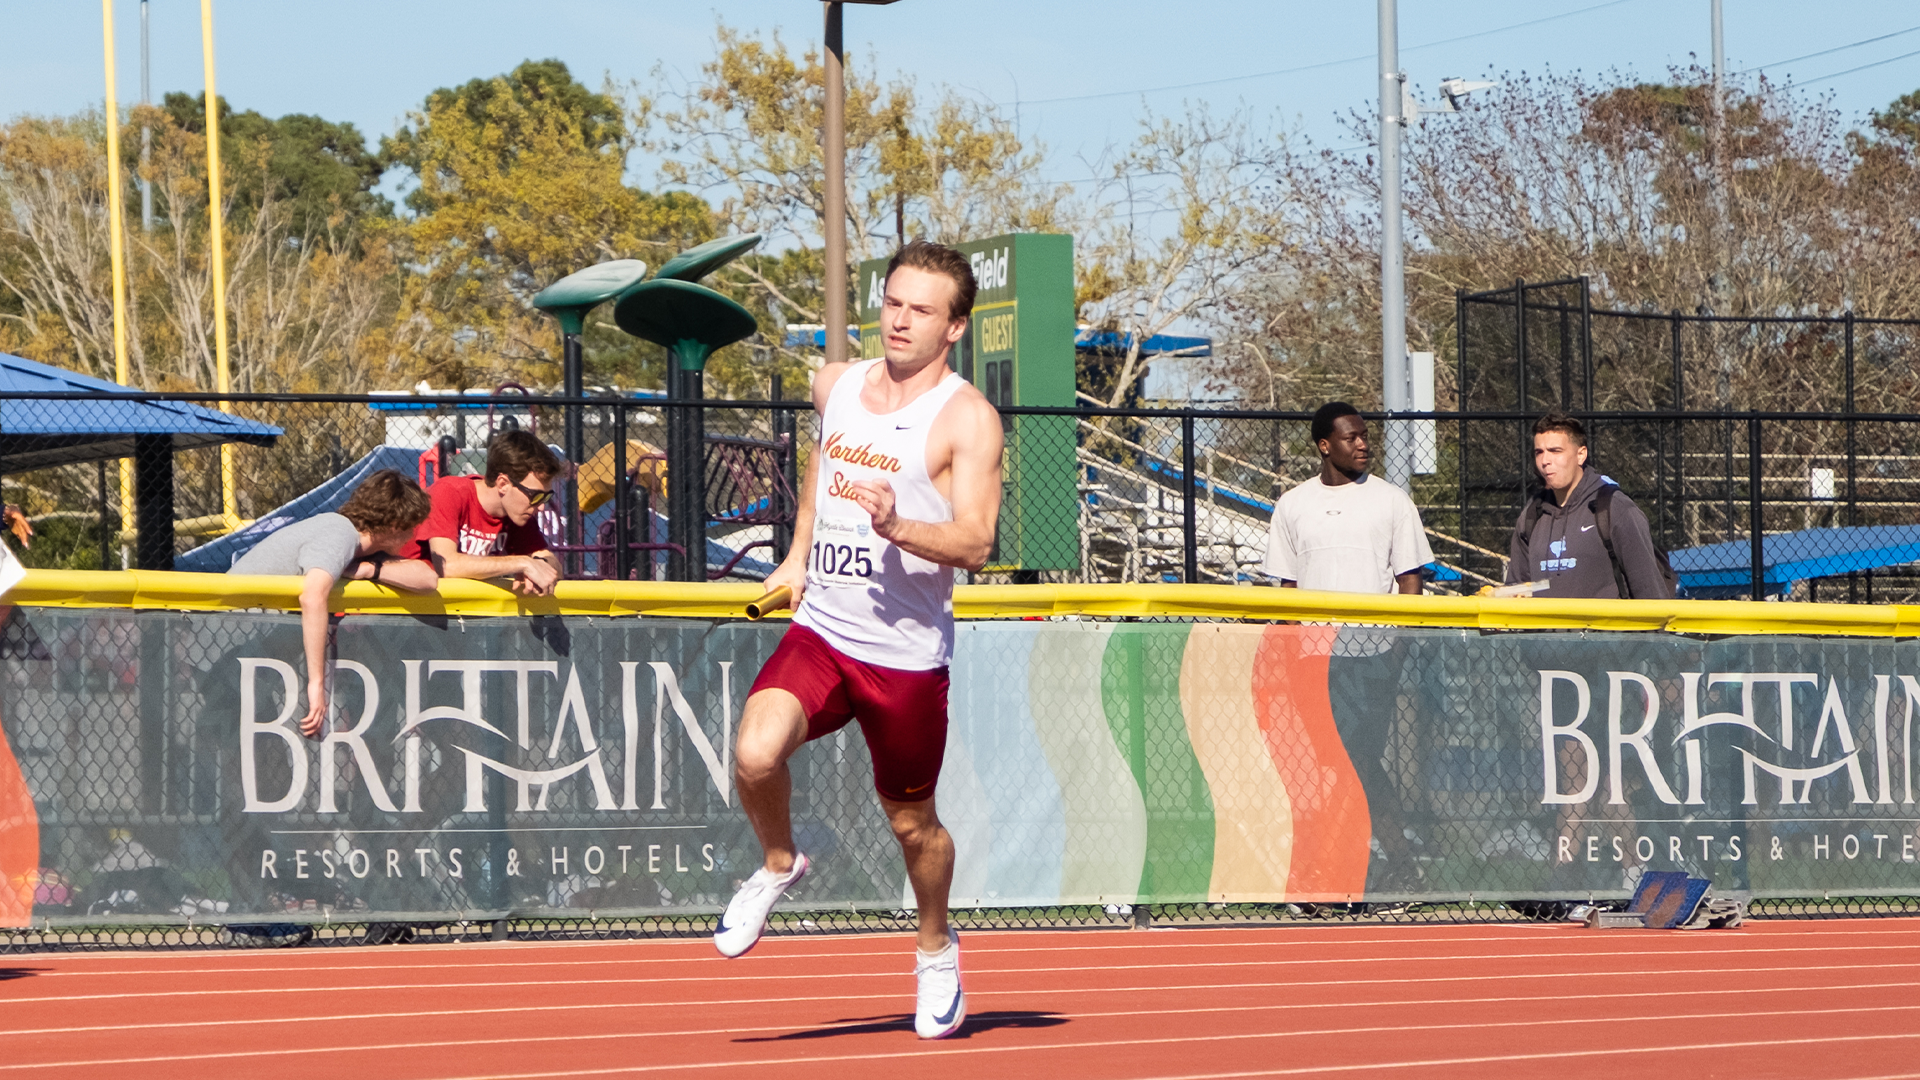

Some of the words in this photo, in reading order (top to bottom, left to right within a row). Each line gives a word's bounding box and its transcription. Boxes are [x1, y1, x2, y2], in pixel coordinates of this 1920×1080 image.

[971, 246, 1009, 290] Field
[982, 313, 1014, 354] GUEST
[822, 431, 901, 473] Northern
[828, 471, 858, 501] Sta
[813, 540, 873, 578] 1025
[237, 657, 734, 813] BRITTAIN
[1538, 669, 1920, 806] BRITTAI
[260, 847, 464, 879] RESORTS
[506, 848, 521, 877] &
[551, 842, 715, 876] HOTELS
[1557, 834, 1743, 862] RESORTS
[1770, 836, 1784, 861] &
